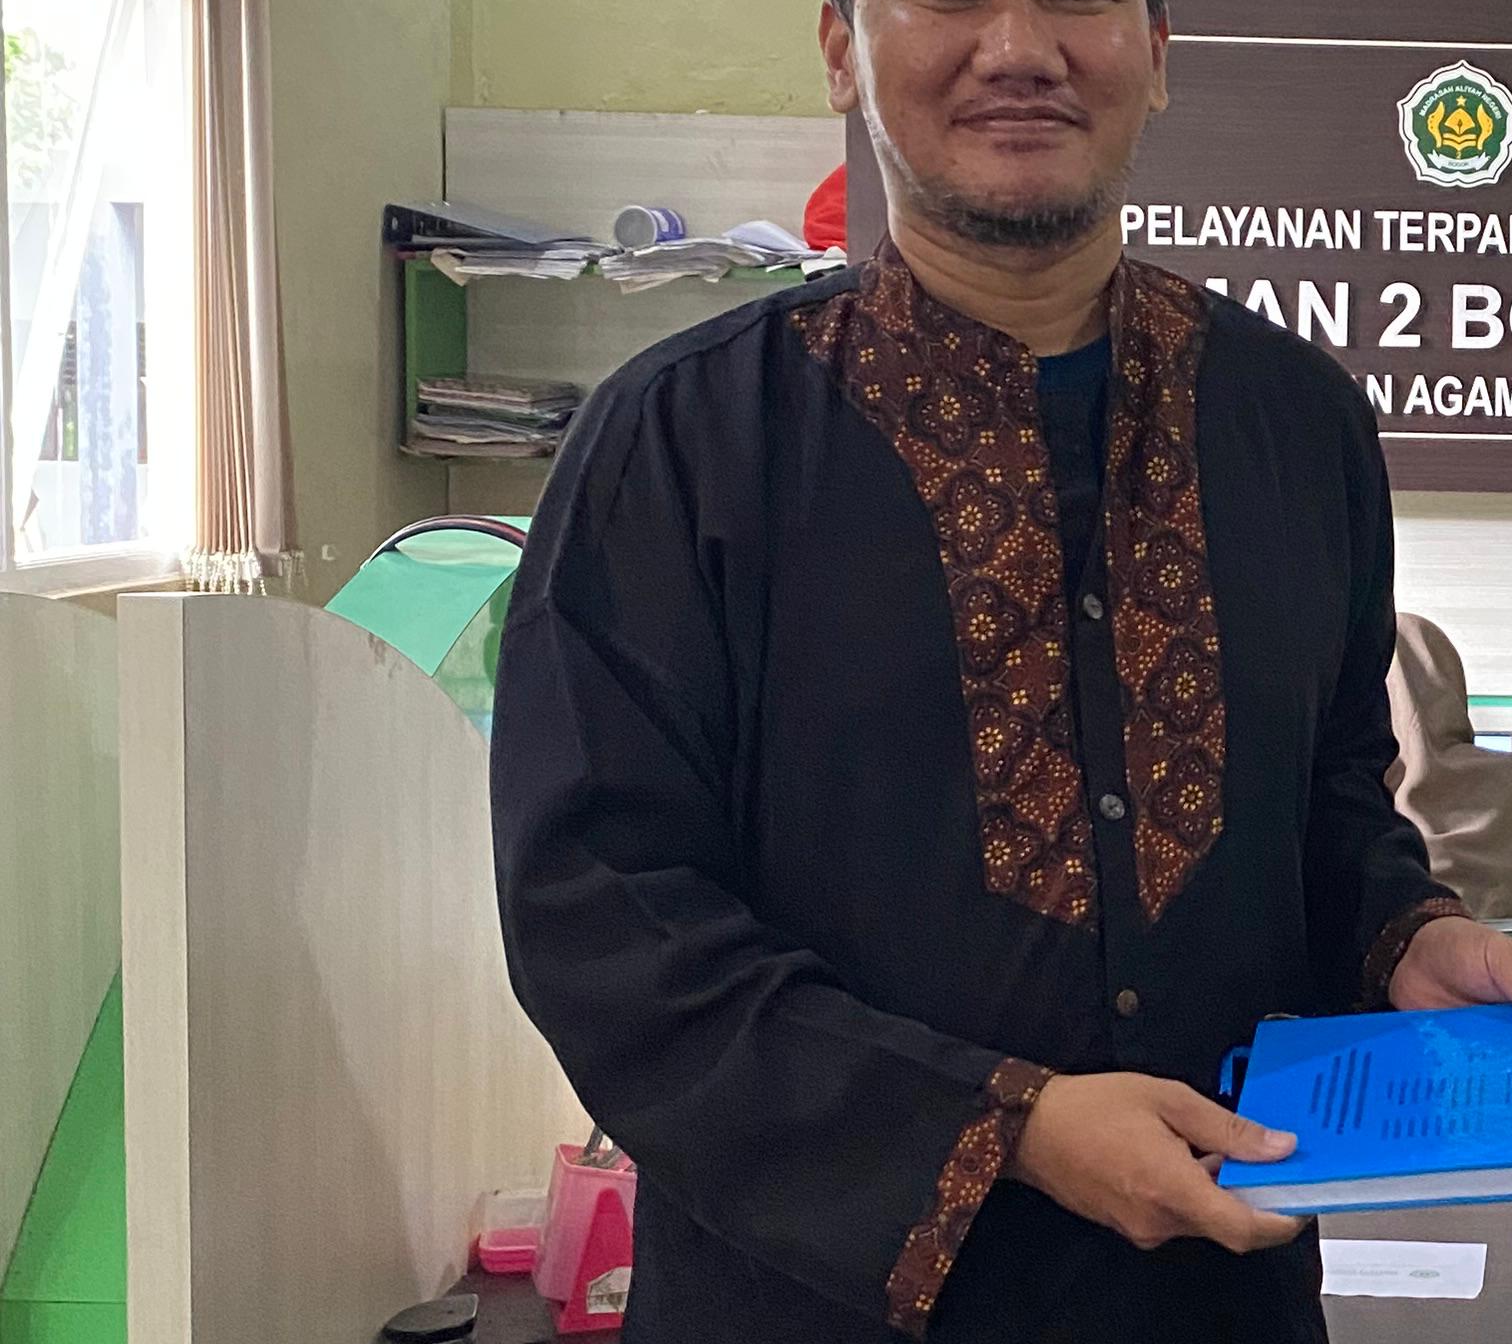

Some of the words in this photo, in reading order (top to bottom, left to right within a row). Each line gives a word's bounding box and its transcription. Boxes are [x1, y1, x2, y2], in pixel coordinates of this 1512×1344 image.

[1119, 204, 1361, 250] PELAYANAN
[1205, 277, 1349, 348] AN
[1378, 282, 1422, 348] 2
